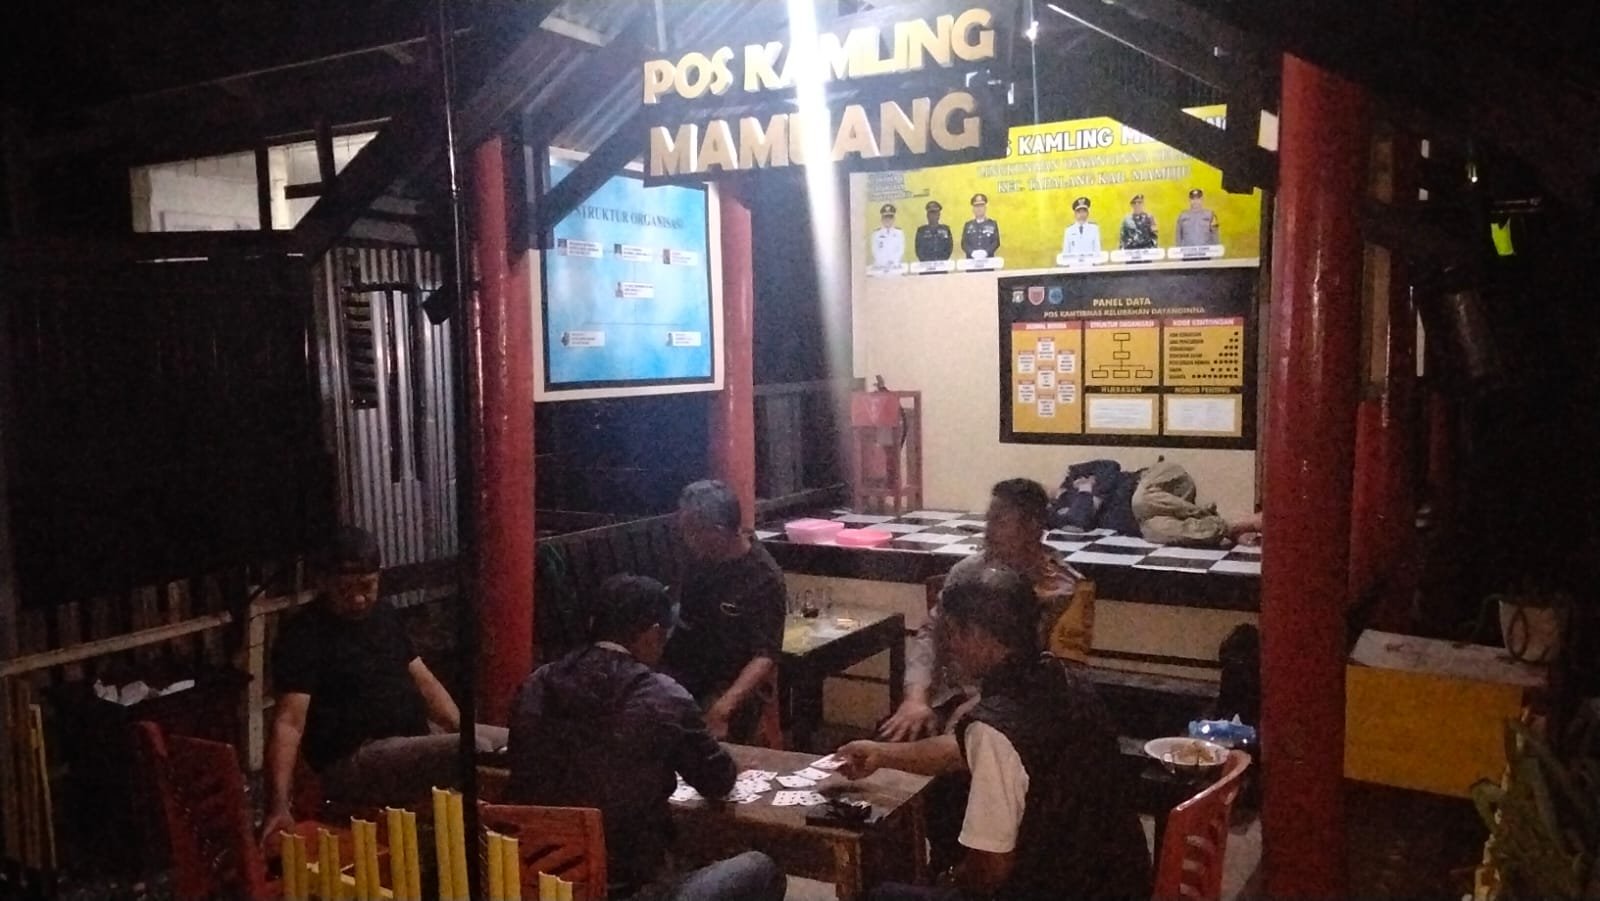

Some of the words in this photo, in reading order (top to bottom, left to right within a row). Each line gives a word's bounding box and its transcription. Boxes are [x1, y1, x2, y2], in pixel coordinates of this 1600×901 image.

[643, 45, 735, 105] POS
[743, 7, 996, 94] KAMLING
[649, 90, 981, 177] MAMUANG
[1018, 126, 1115, 157] KAMLING
[1043, 311, 1059, 319] POS
[1092, 297, 1124, 307] PANEL
[1125, 296, 1152, 306] DATA
